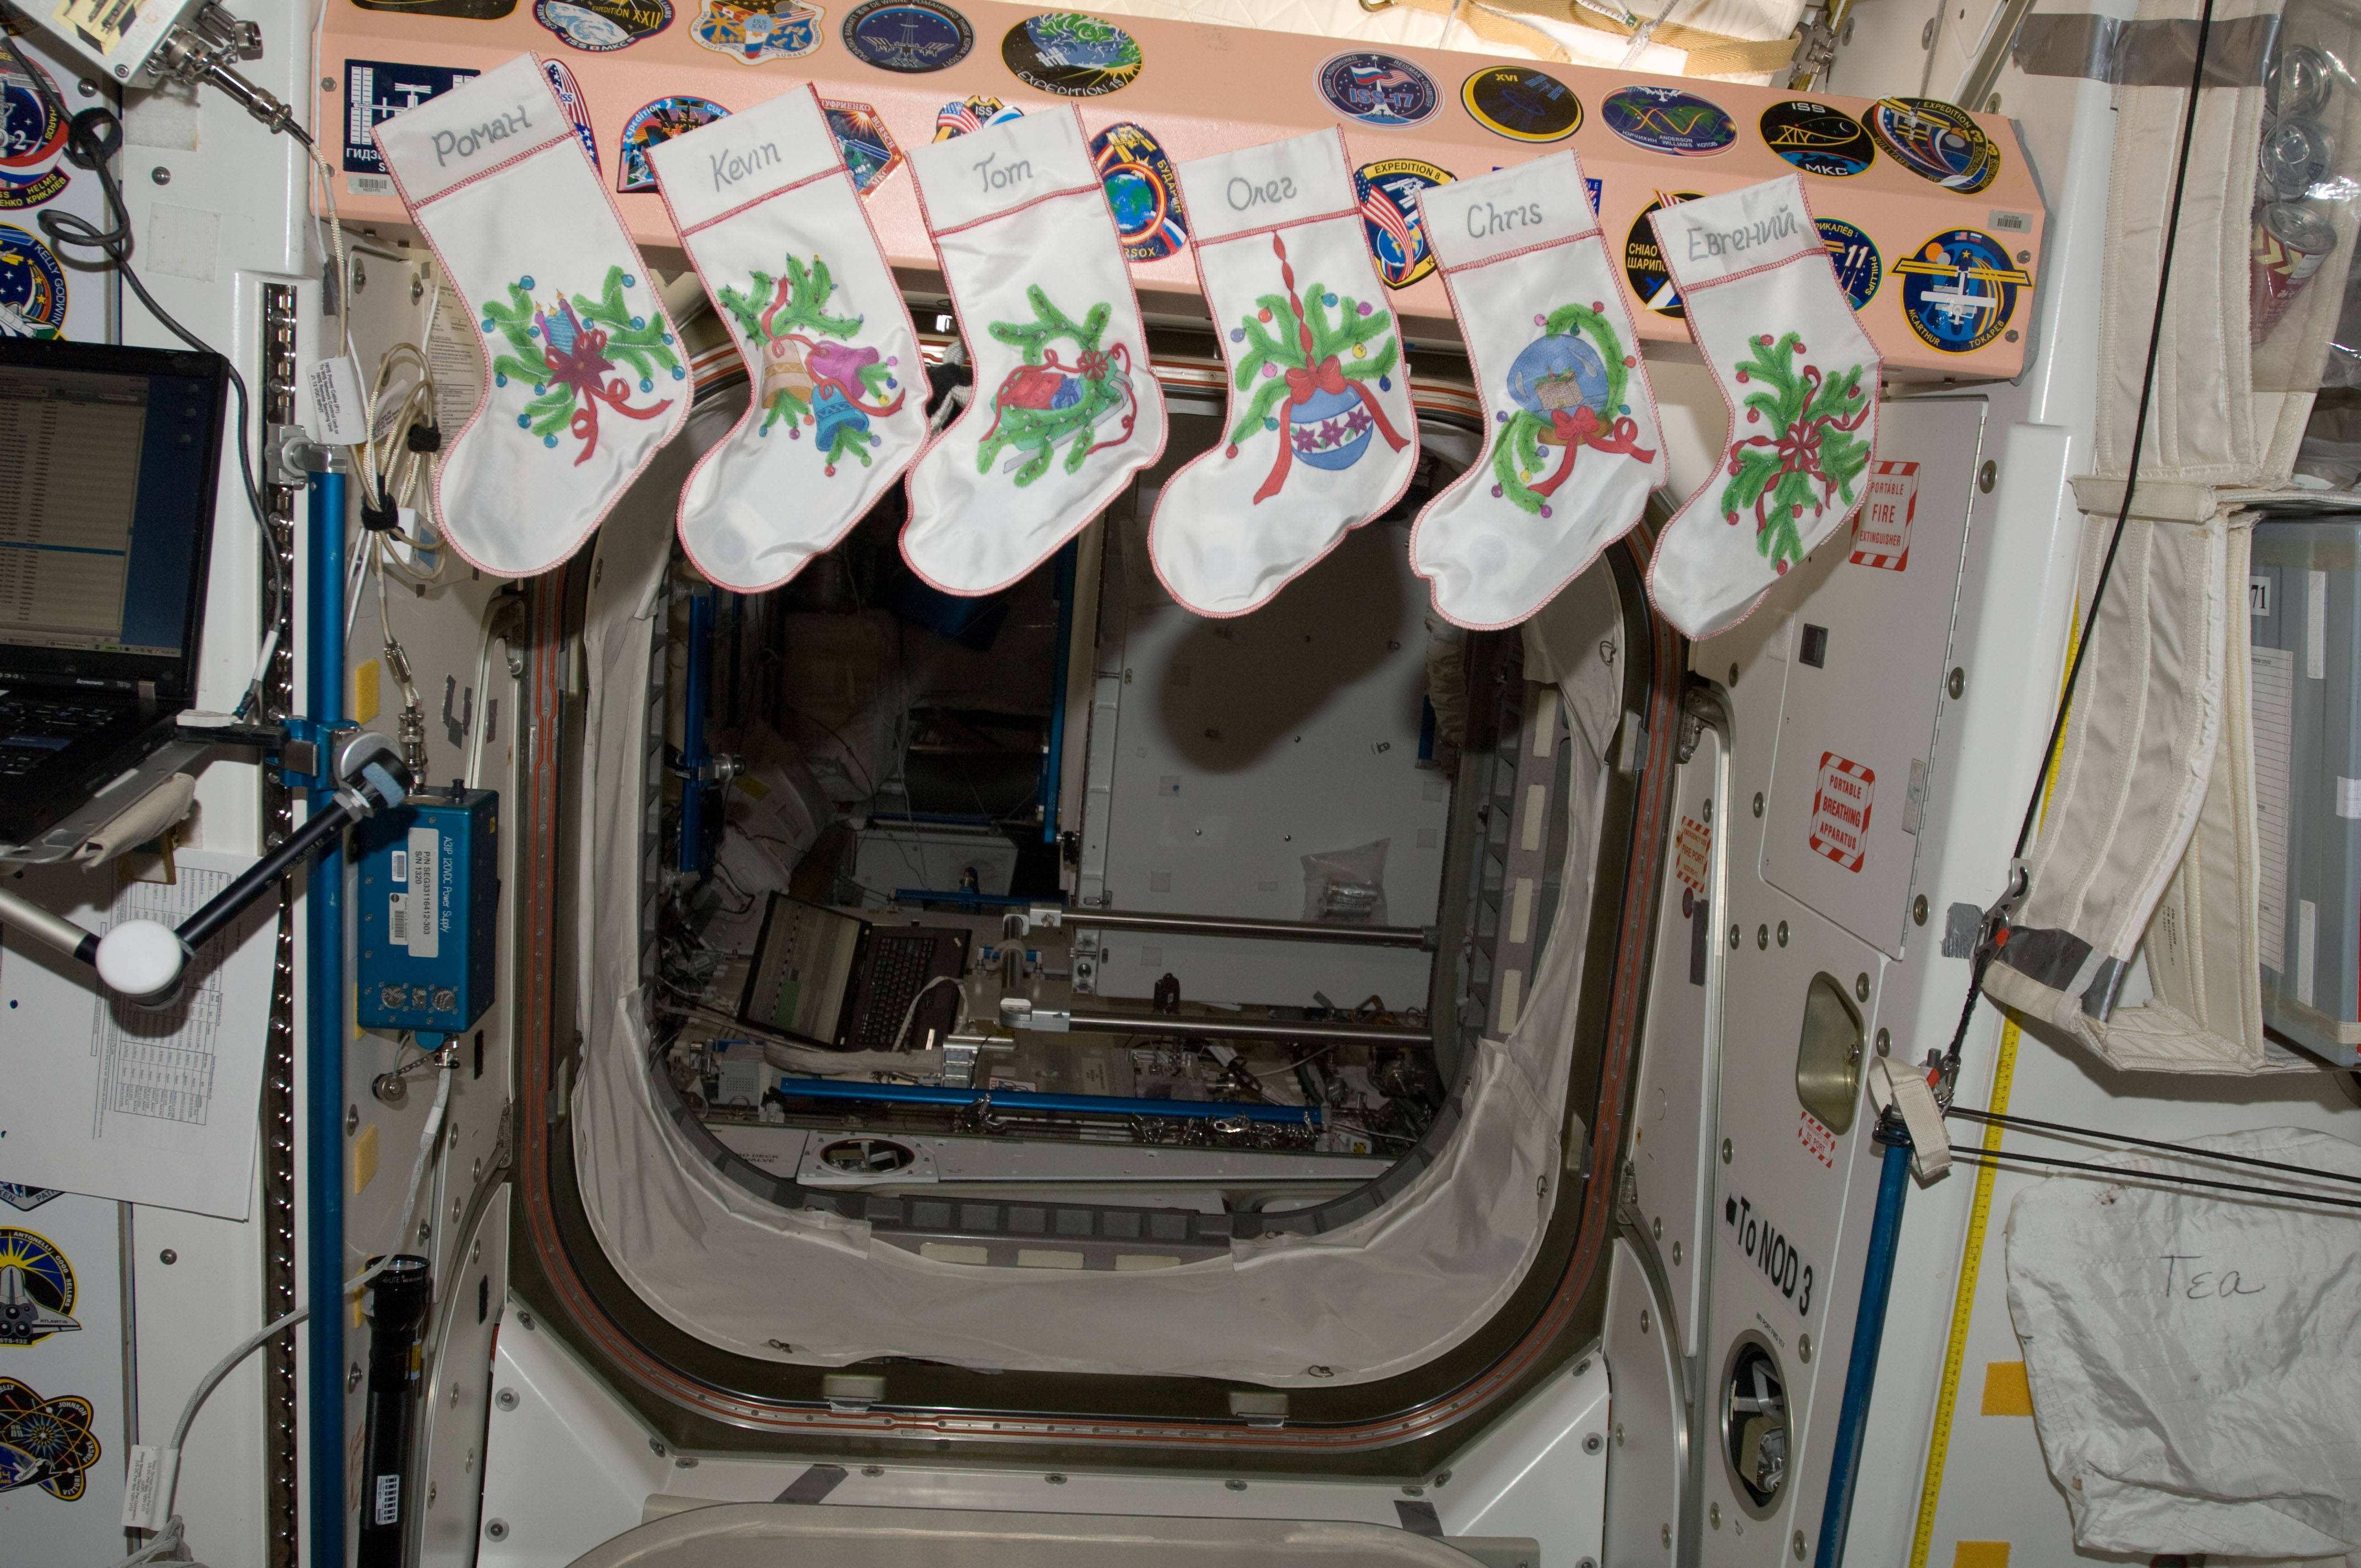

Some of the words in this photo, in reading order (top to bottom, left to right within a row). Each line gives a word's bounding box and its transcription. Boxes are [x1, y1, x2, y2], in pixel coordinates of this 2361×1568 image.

[537, 4, 557, 30] CREAMER
[591, 6, 630, 18] EXPEDITION
[633, 10, 661, 29] XXII
[692, 10, 709, 32] WILLIAMS
[565, 37, 587, 50] ISS
[700, 40, 722, 51] STOTT
[942, 54, 962, 68] STOTT
[1393, 59, 1423, 78] REISMAN
[1018, 70, 1109, 96] EXPEDITION
[1109, 79, 1124, 90] 19
[1495, 73, 1519, 82] XVI
[664, 99, 672, 109] 3
[1349, 88, 1413, 108] ISS-17
[1792, 102, 1825, 113] ISS
[975, 105, 993, 116] ISS
[1923, 101, 1971, 129] EXPEDITION
[871, 115, 895, 149] BURSCH
[1659, 135, 1693, 143] ANDERSON
[1960, 129, 1984, 143] 13
[1874, 136, 1910, 168] WILLIAMS
[710, 141, 782, 192] Kevin
[973, 151, 1033, 193] Tom
[1374, 162, 1434, 176] EXPEDITION
[28, 173, 57, 195] HELMS
[1467, 200, 1544, 239] Chris
[1629, 243, 1658, 257] CHIAO
[1845, 244, 1869, 268] 11
[34, 244, 61, 274] KELLY
[51, 278, 66, 325] GODWIN
[1865, 256, 1879, 296] PHILLIPS
[1909, 309, 1940, 346] MCARTHUR
[1871, 482, 1905, 496] PORTABLE
[1872, 504, 1896, 523] FIRE
[1859, 530, 1902, 546] EXTINGUISHER
[1829, 775, 1862, 799] PORTABLE
[1823, 796, 1861, 827] BREATHING
[1820, 821, 1857, 850] APPARATUS
[1682, 844, 1691, 858] FIRE
[1692, 850, 1705, 864] PORT
[442, 886, 451, 908] Power
[440, 910, 451, 933] Supply
[1814, 1138, 1825, 1153] PORT
[1738, 1195, 1756, 1257] To
[1758, 1220, 1798, 1299] NOD
[1799, 1265, 1813, 1316] 3
[13, 1231, 52, 1252] ANTONELLI
[55, 1255, 69, 1273] GOOD
[64, 1278, 74, 1308] SELLERS
[2159, 1255, 2266, 1300] Tea
[58, 1402, 88, 1417] JOHNSON
[83, 1440, 95, 1463] FINCKE
[63, 1475, 81, 1496] VITTORI
